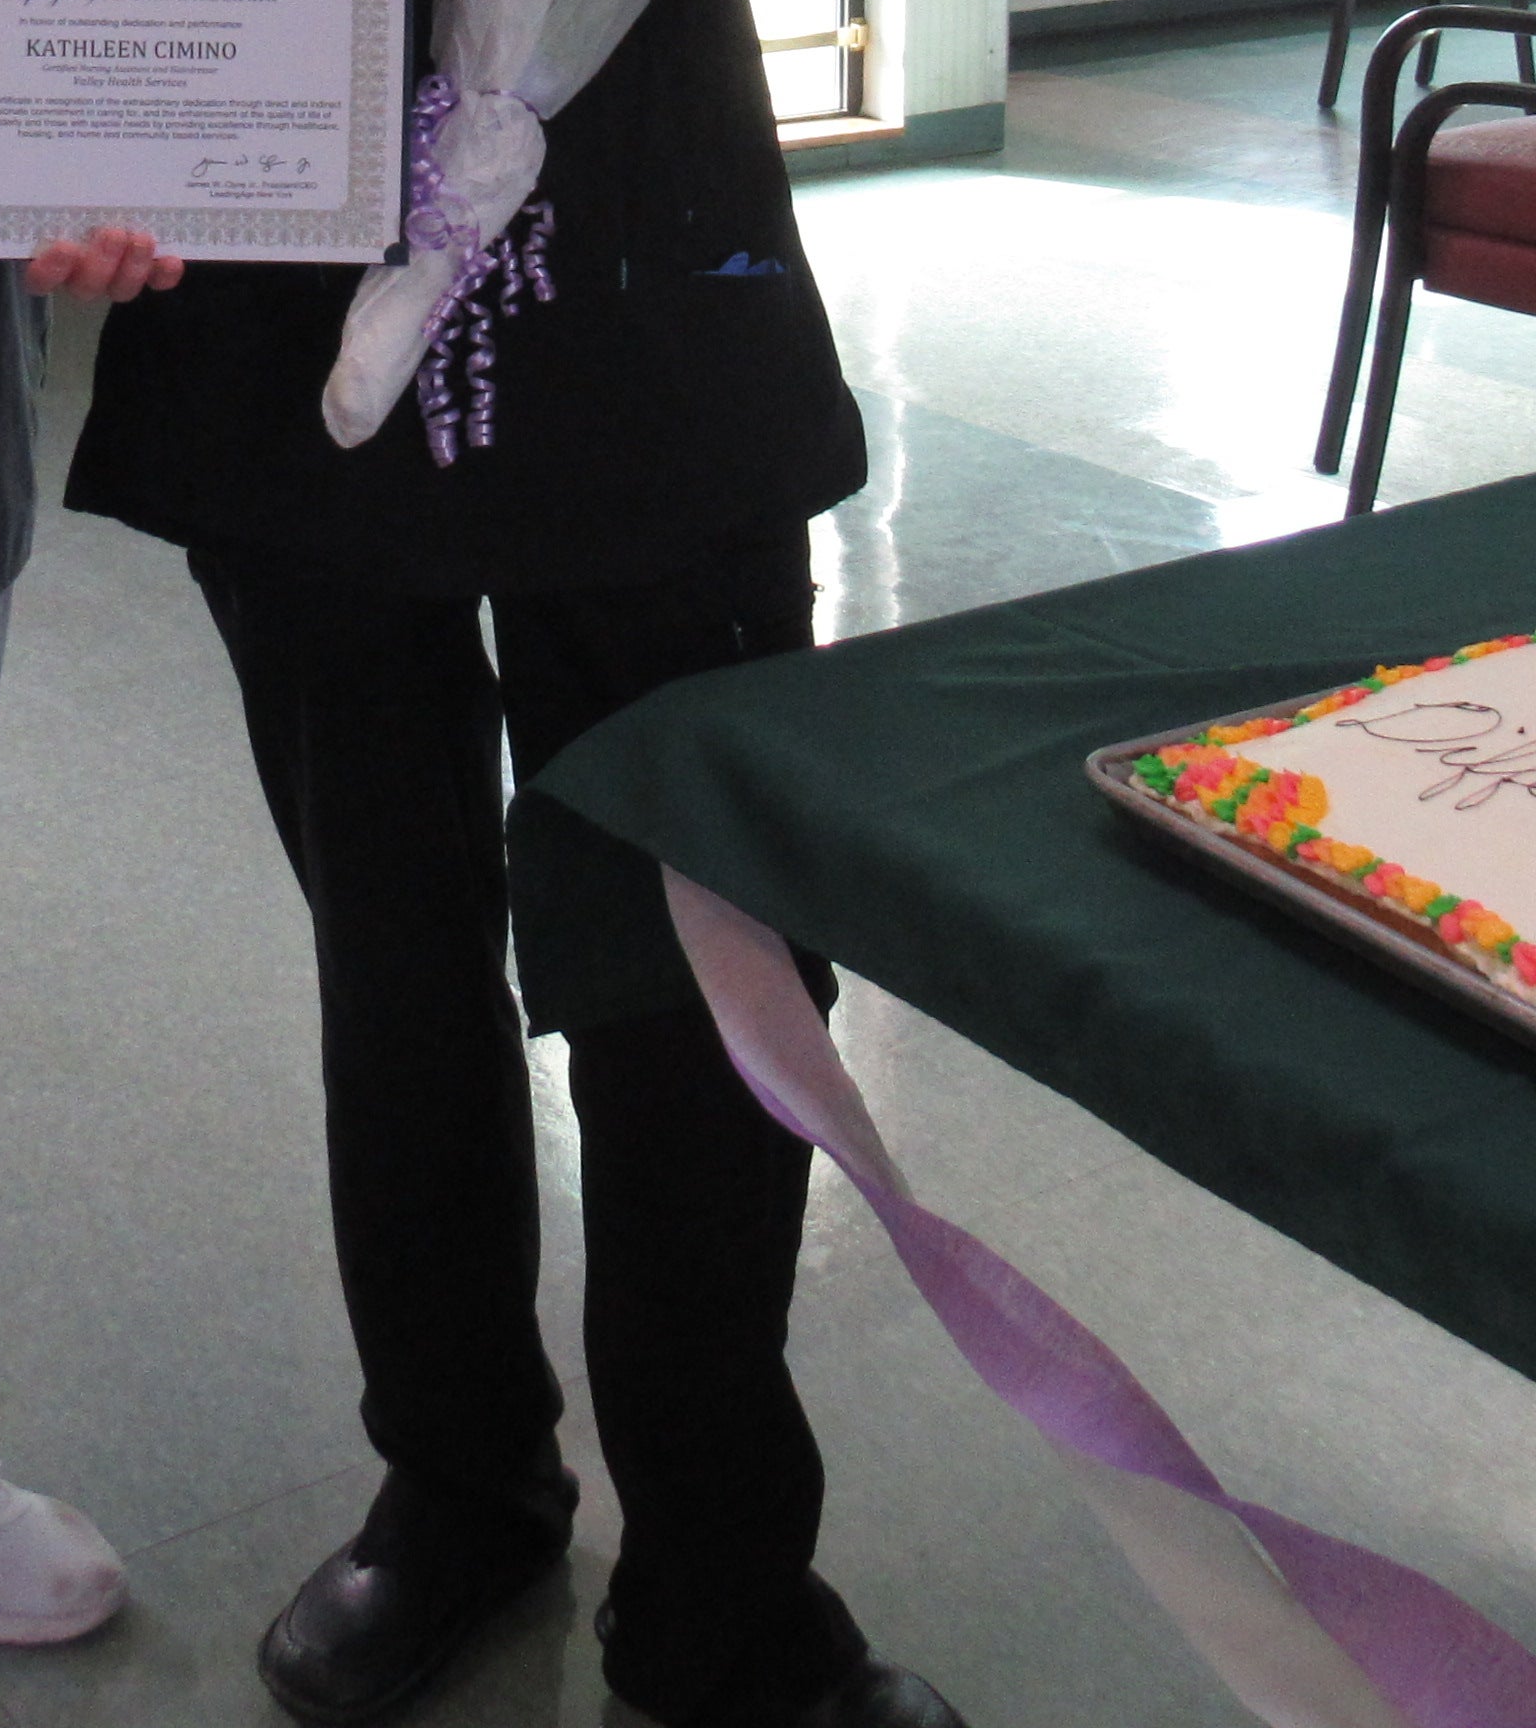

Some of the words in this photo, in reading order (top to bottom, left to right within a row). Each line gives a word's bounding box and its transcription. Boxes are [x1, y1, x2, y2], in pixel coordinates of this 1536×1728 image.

[26, 38, 147, 58] KATHLEEN
[154, 41, 237, 60] CIMINO
[73, 76, 105, 88] Valley
[107, 77, 143, 86] Health
[145, 78, 187, 87] Services
